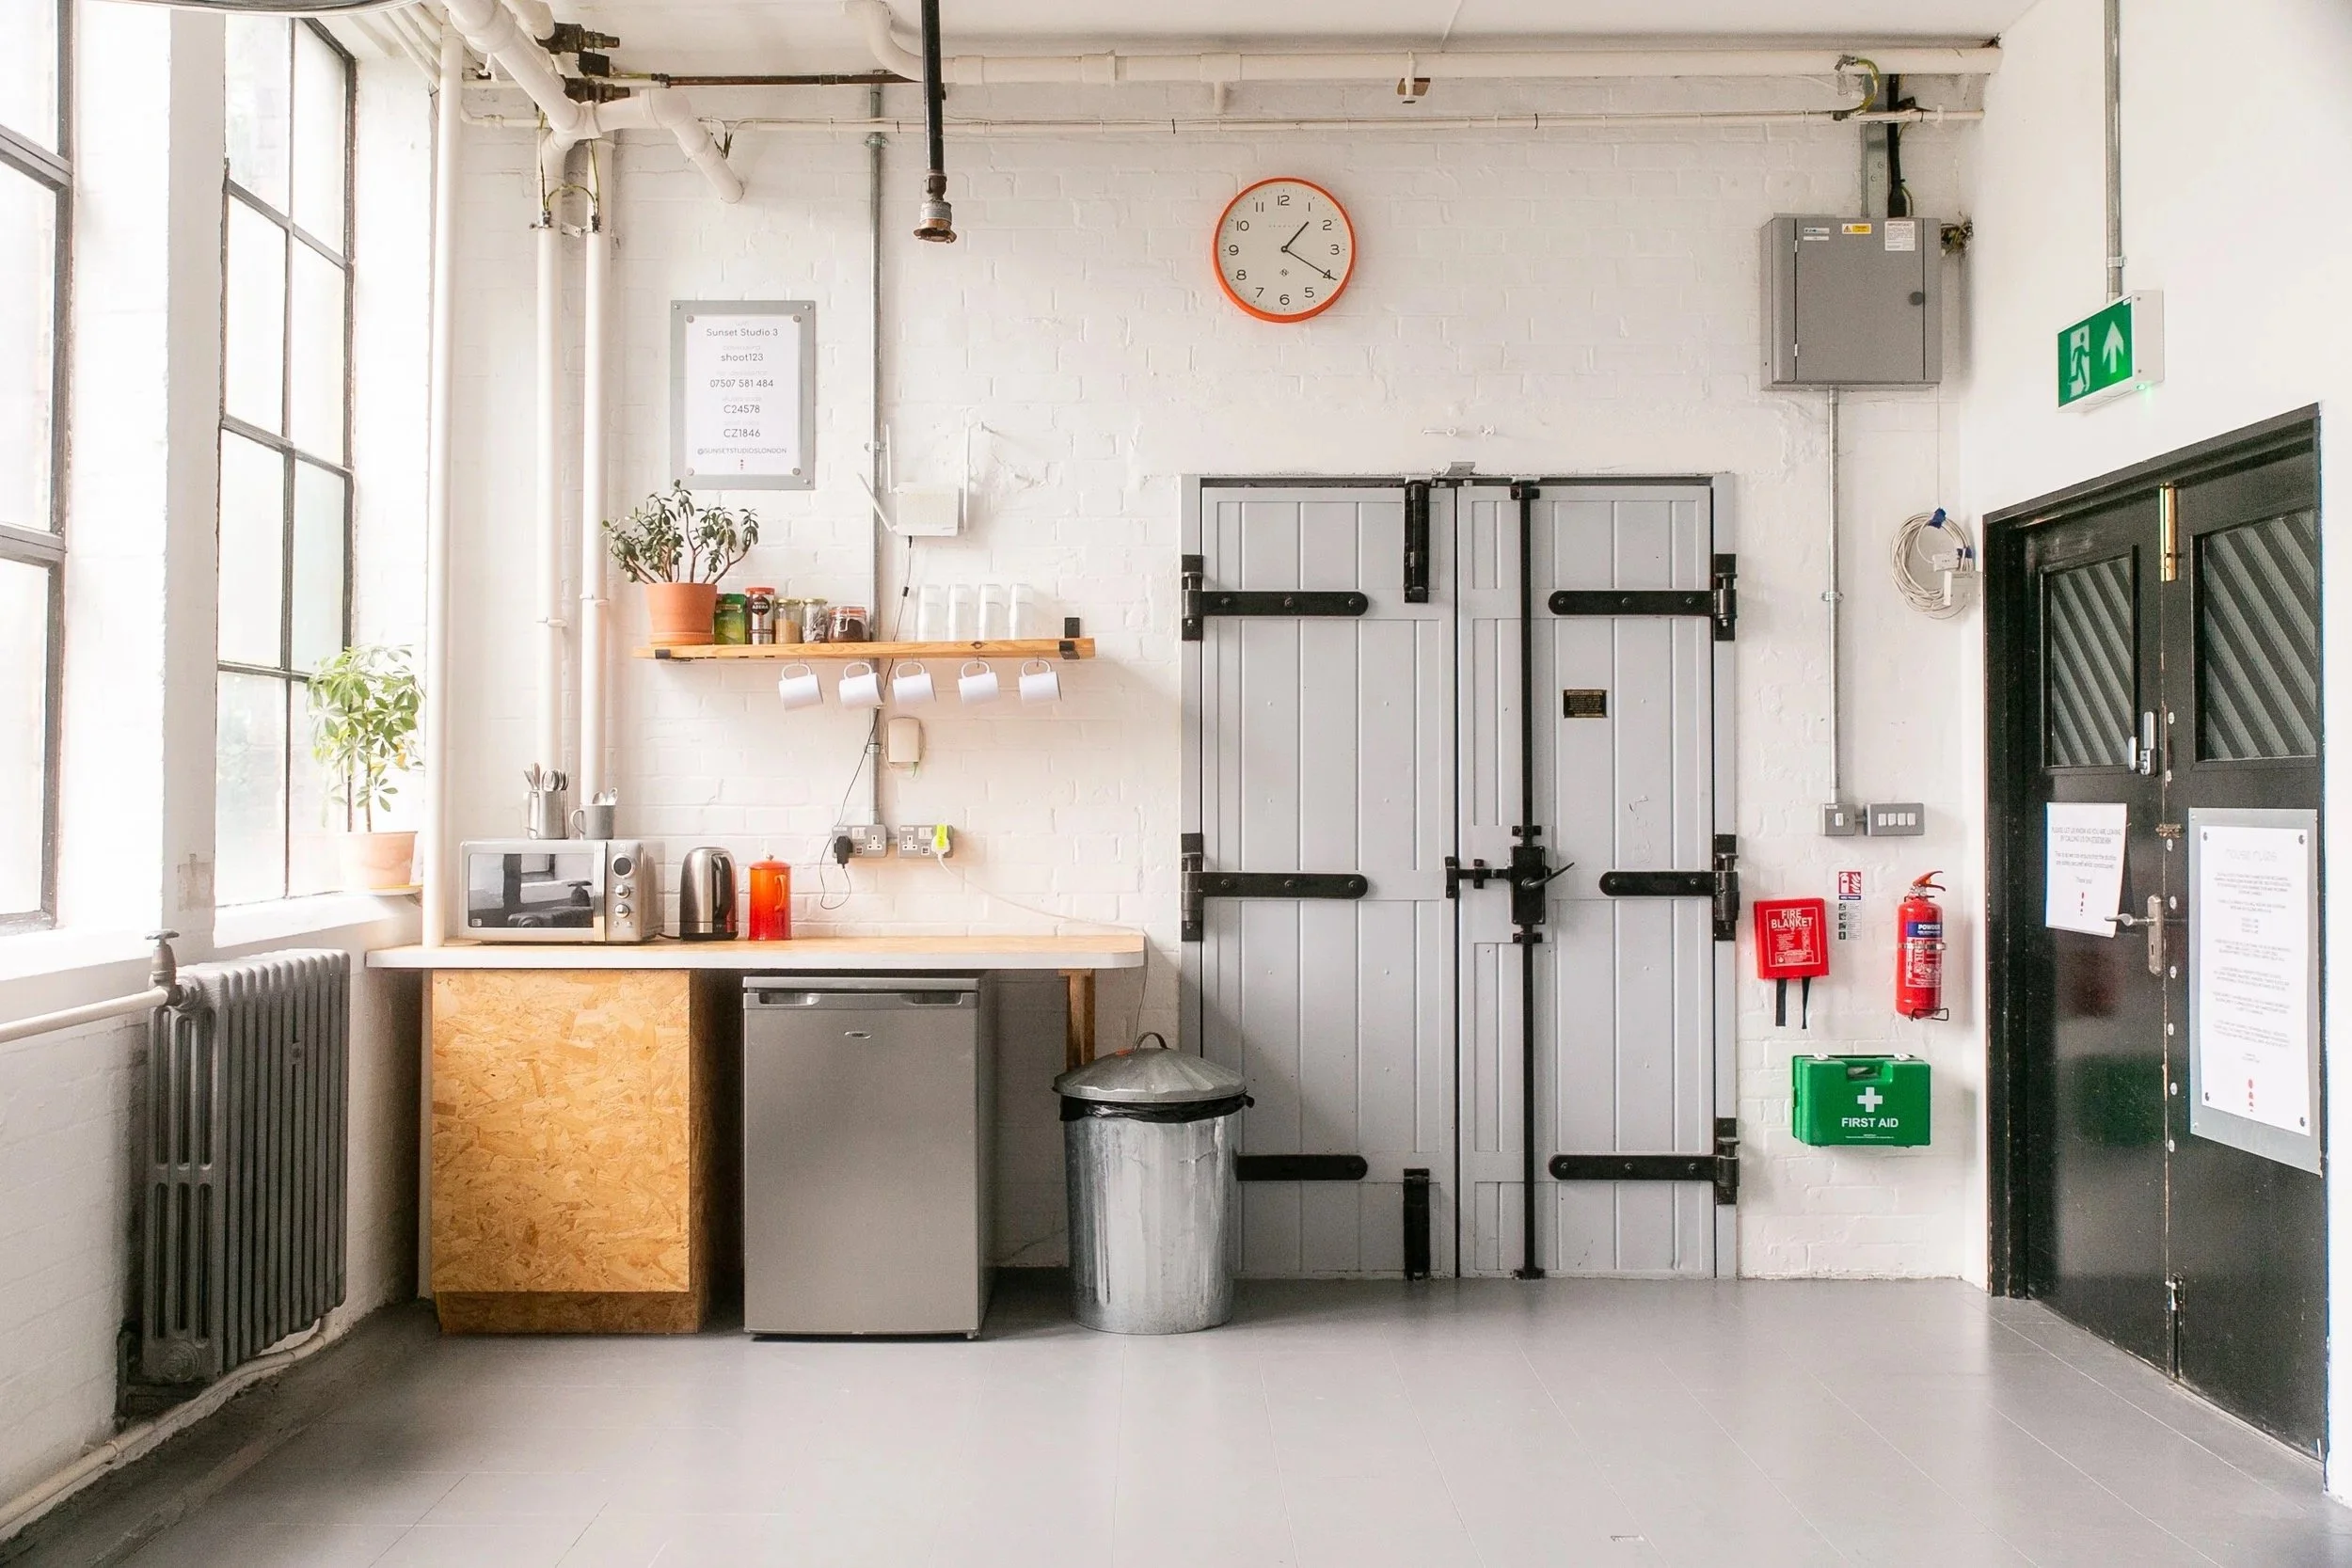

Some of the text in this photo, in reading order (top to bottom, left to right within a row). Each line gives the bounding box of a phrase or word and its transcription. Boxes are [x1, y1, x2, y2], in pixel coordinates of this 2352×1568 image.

[1277, 195, 1290, 206] 12
[1255, 201, 1264, 213] 11
[1308, 201, 1311, 213] 1
[1236, 220, 1249, 231] 10
[1322, 219, 1332, 231] 2
[1228, 245, 1239, 256] 9
[1329, 244, 1340, 256] 3
[1235, 269, 1247, 280] 8
[1322, 269, 1331, 280] 4
[1255, 287, 1264, 298] 7
[1304, 287, 1314, 298] 5
[1279, 294, 1290, 306] 6
[707, 328, 778, 337] Sunset Studio 3
[721, 353, 764, 361] shoot123
[709, 379, 773, 388] 07507 581 484
[723, 404, 760, 414] C24578
[723, 429, 761, 438] CZ1846
[1781, 909, 1803, 920] FIRE
[1771, 917, 1813, 929] BLANKET
[1841, 1117, 1899, 1128] FIRST AID
